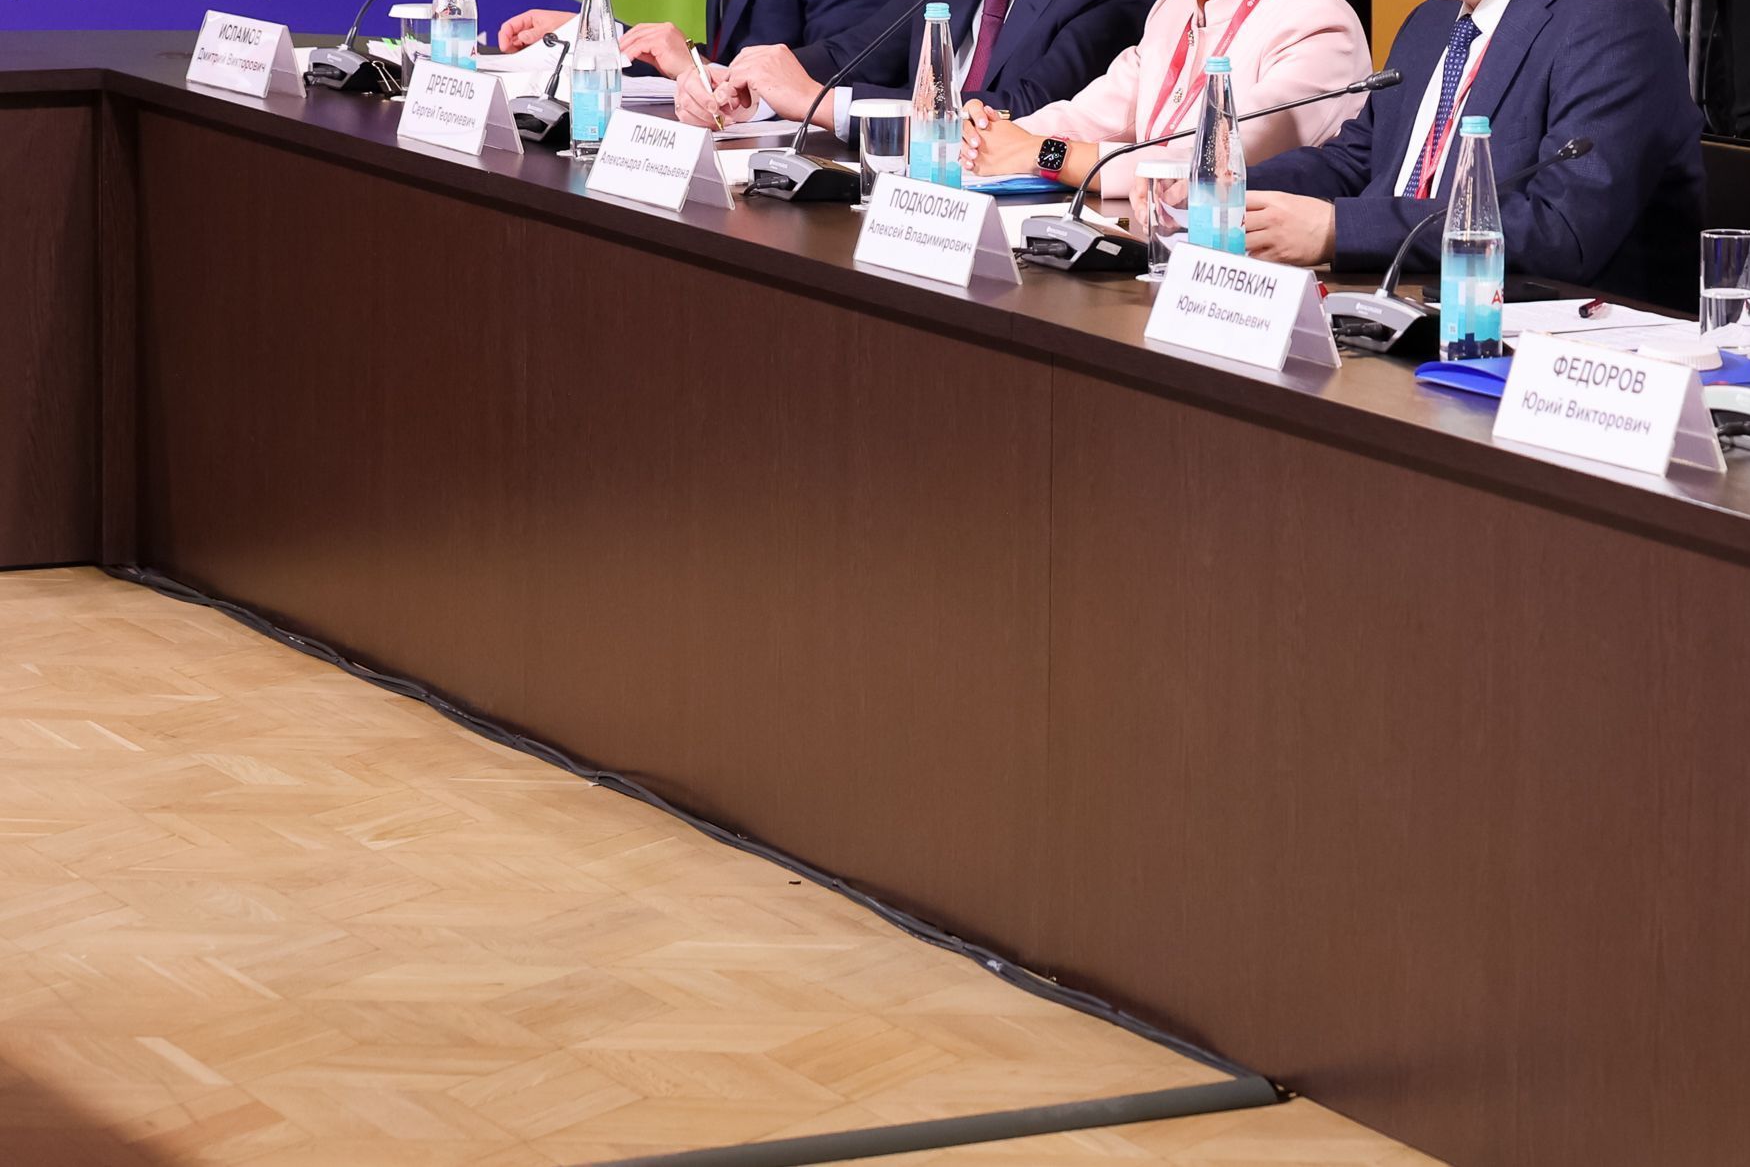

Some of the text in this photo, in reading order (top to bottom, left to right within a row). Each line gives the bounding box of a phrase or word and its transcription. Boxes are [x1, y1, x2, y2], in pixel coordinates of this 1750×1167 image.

[218, 23, 263, 46] ИСЛАМОВ
[426, 73, 476, 100] ДРЕГВАЛЬ
[411, 100, 476, 128] Сергей Георгиевич
[630, 124, 677, 150] ПАНИНА
[600, 151, 690, 179] Александра Геннадьевна
[889, 187, 969, 222] ПОДКОЛЗИН
[867, 219, 973, 253] Алексей Владимирович
[1191, 260, 1278, 299] МАЛЯВКИН
[1176, 294, 1272, 331] Юрий Васильевич
[1553, 354, 1647, 394] ФЕДОРОВ
[1521, 389, 1652, 435] Юрий Викторович
